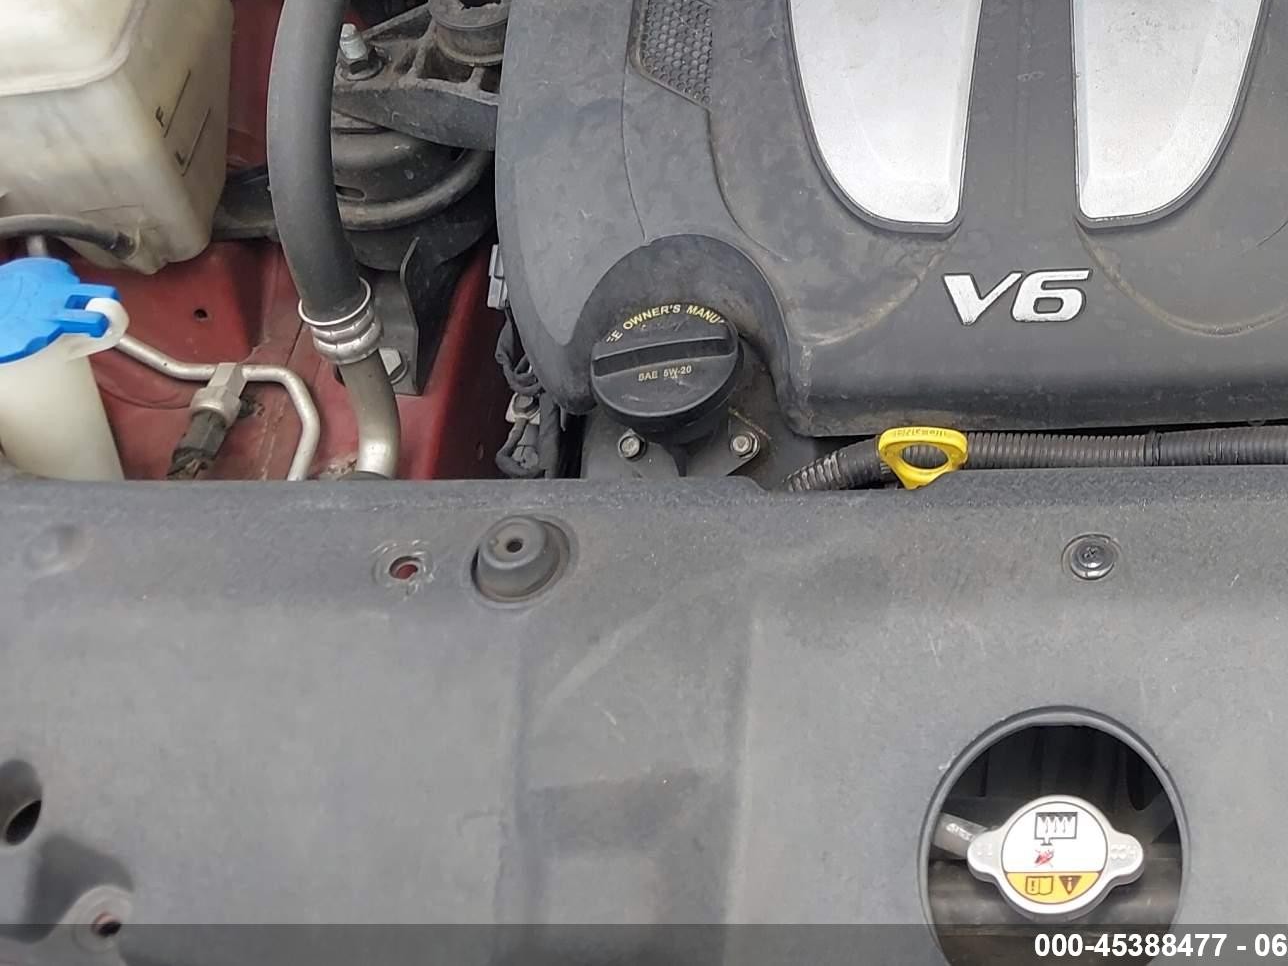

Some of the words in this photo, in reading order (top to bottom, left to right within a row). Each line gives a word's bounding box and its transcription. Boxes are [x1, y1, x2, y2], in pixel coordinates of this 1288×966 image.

[943, 269, 1091, 325] V6
[622, 303, 682, 331] OWNER'S
[638, 370, 658, 382] SAE
[663, 365, 692, 380] 5W-20
